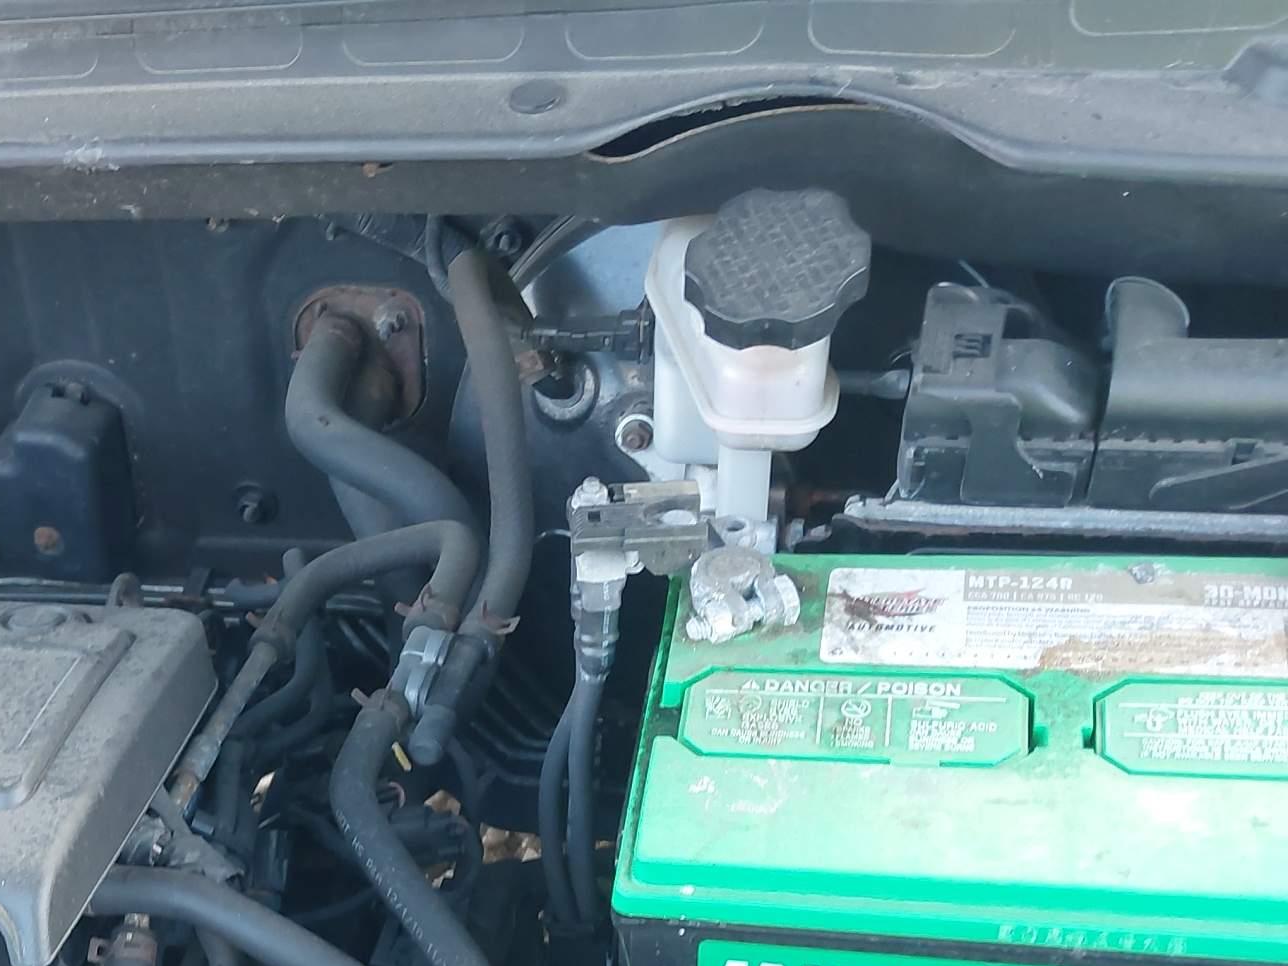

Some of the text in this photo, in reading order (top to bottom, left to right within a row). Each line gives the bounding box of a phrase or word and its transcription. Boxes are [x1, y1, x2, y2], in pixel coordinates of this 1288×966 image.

[968, 575, 1073, 590] MTP-124R
[847, 623, 937, 633] AUTOMOTIVE
[764, 679, 852, 695] DANGER
[876, 682, 961, 697] POISON
[969, 722, 997, 732] ACID
